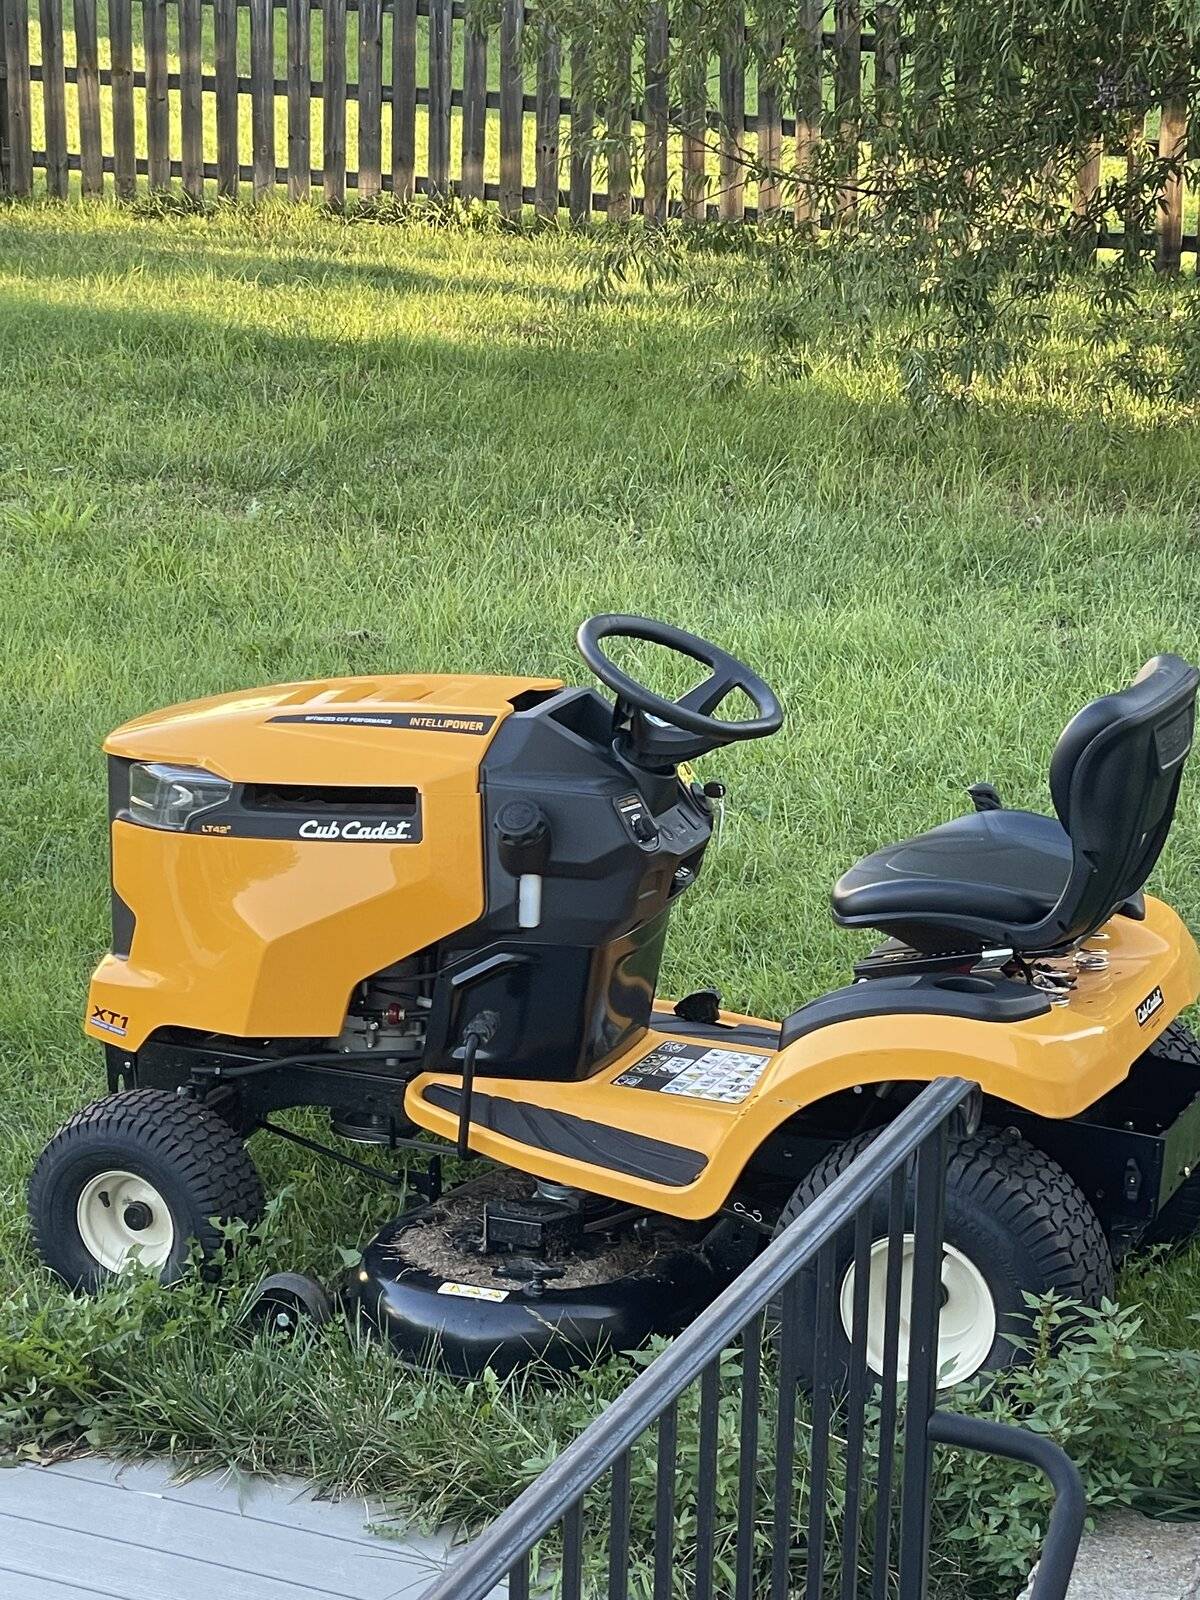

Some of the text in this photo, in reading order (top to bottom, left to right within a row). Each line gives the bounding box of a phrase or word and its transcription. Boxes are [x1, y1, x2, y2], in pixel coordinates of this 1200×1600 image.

[409, 717, 484, 731] INTELLIPOWER
[299, 820, 411, 840] Cub Cadet
[92, 1005, 129, 1029] XT1
